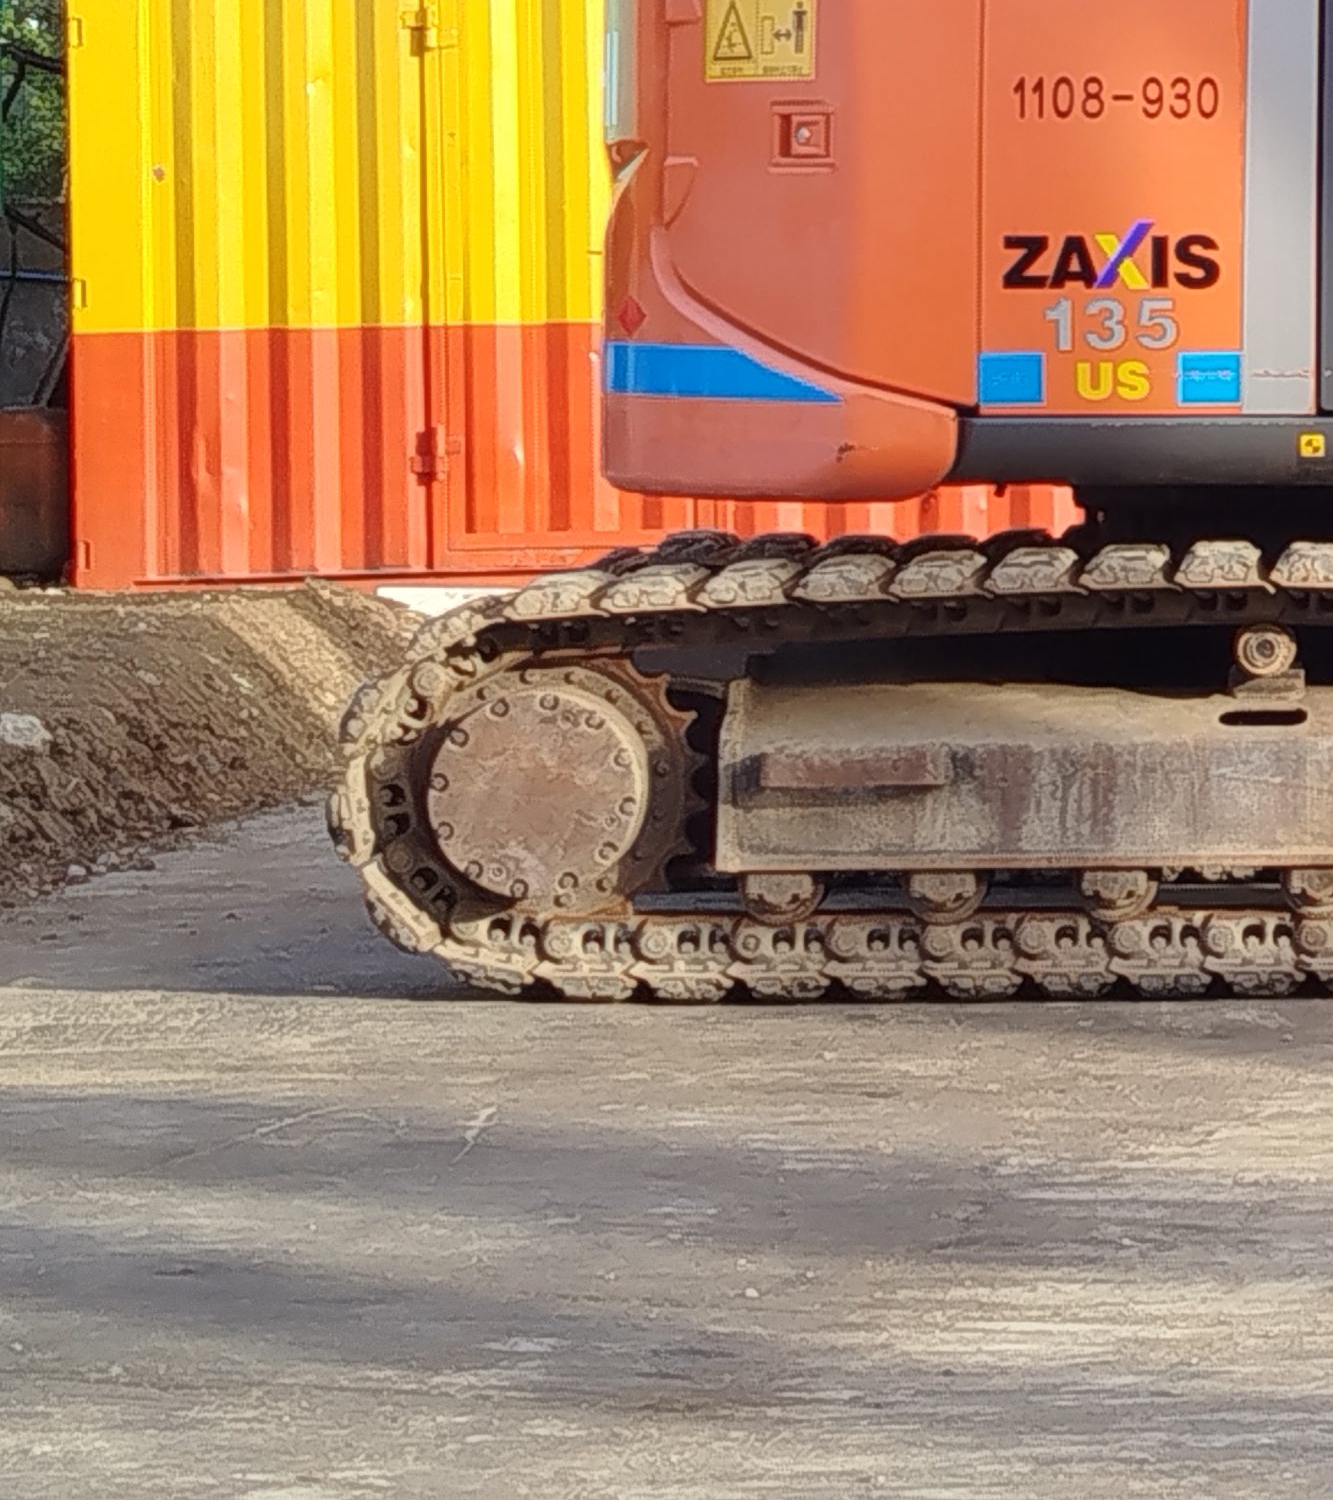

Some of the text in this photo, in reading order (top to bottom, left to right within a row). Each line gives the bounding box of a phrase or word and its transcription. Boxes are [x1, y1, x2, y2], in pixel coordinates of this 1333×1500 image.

[1010, 75, 1221, 121] 1108-930
[1001, 218, 1222, 292] ZAXIS
[1043, 297, 1180, 352] 135
[1075, 360, 1151, 401] US
